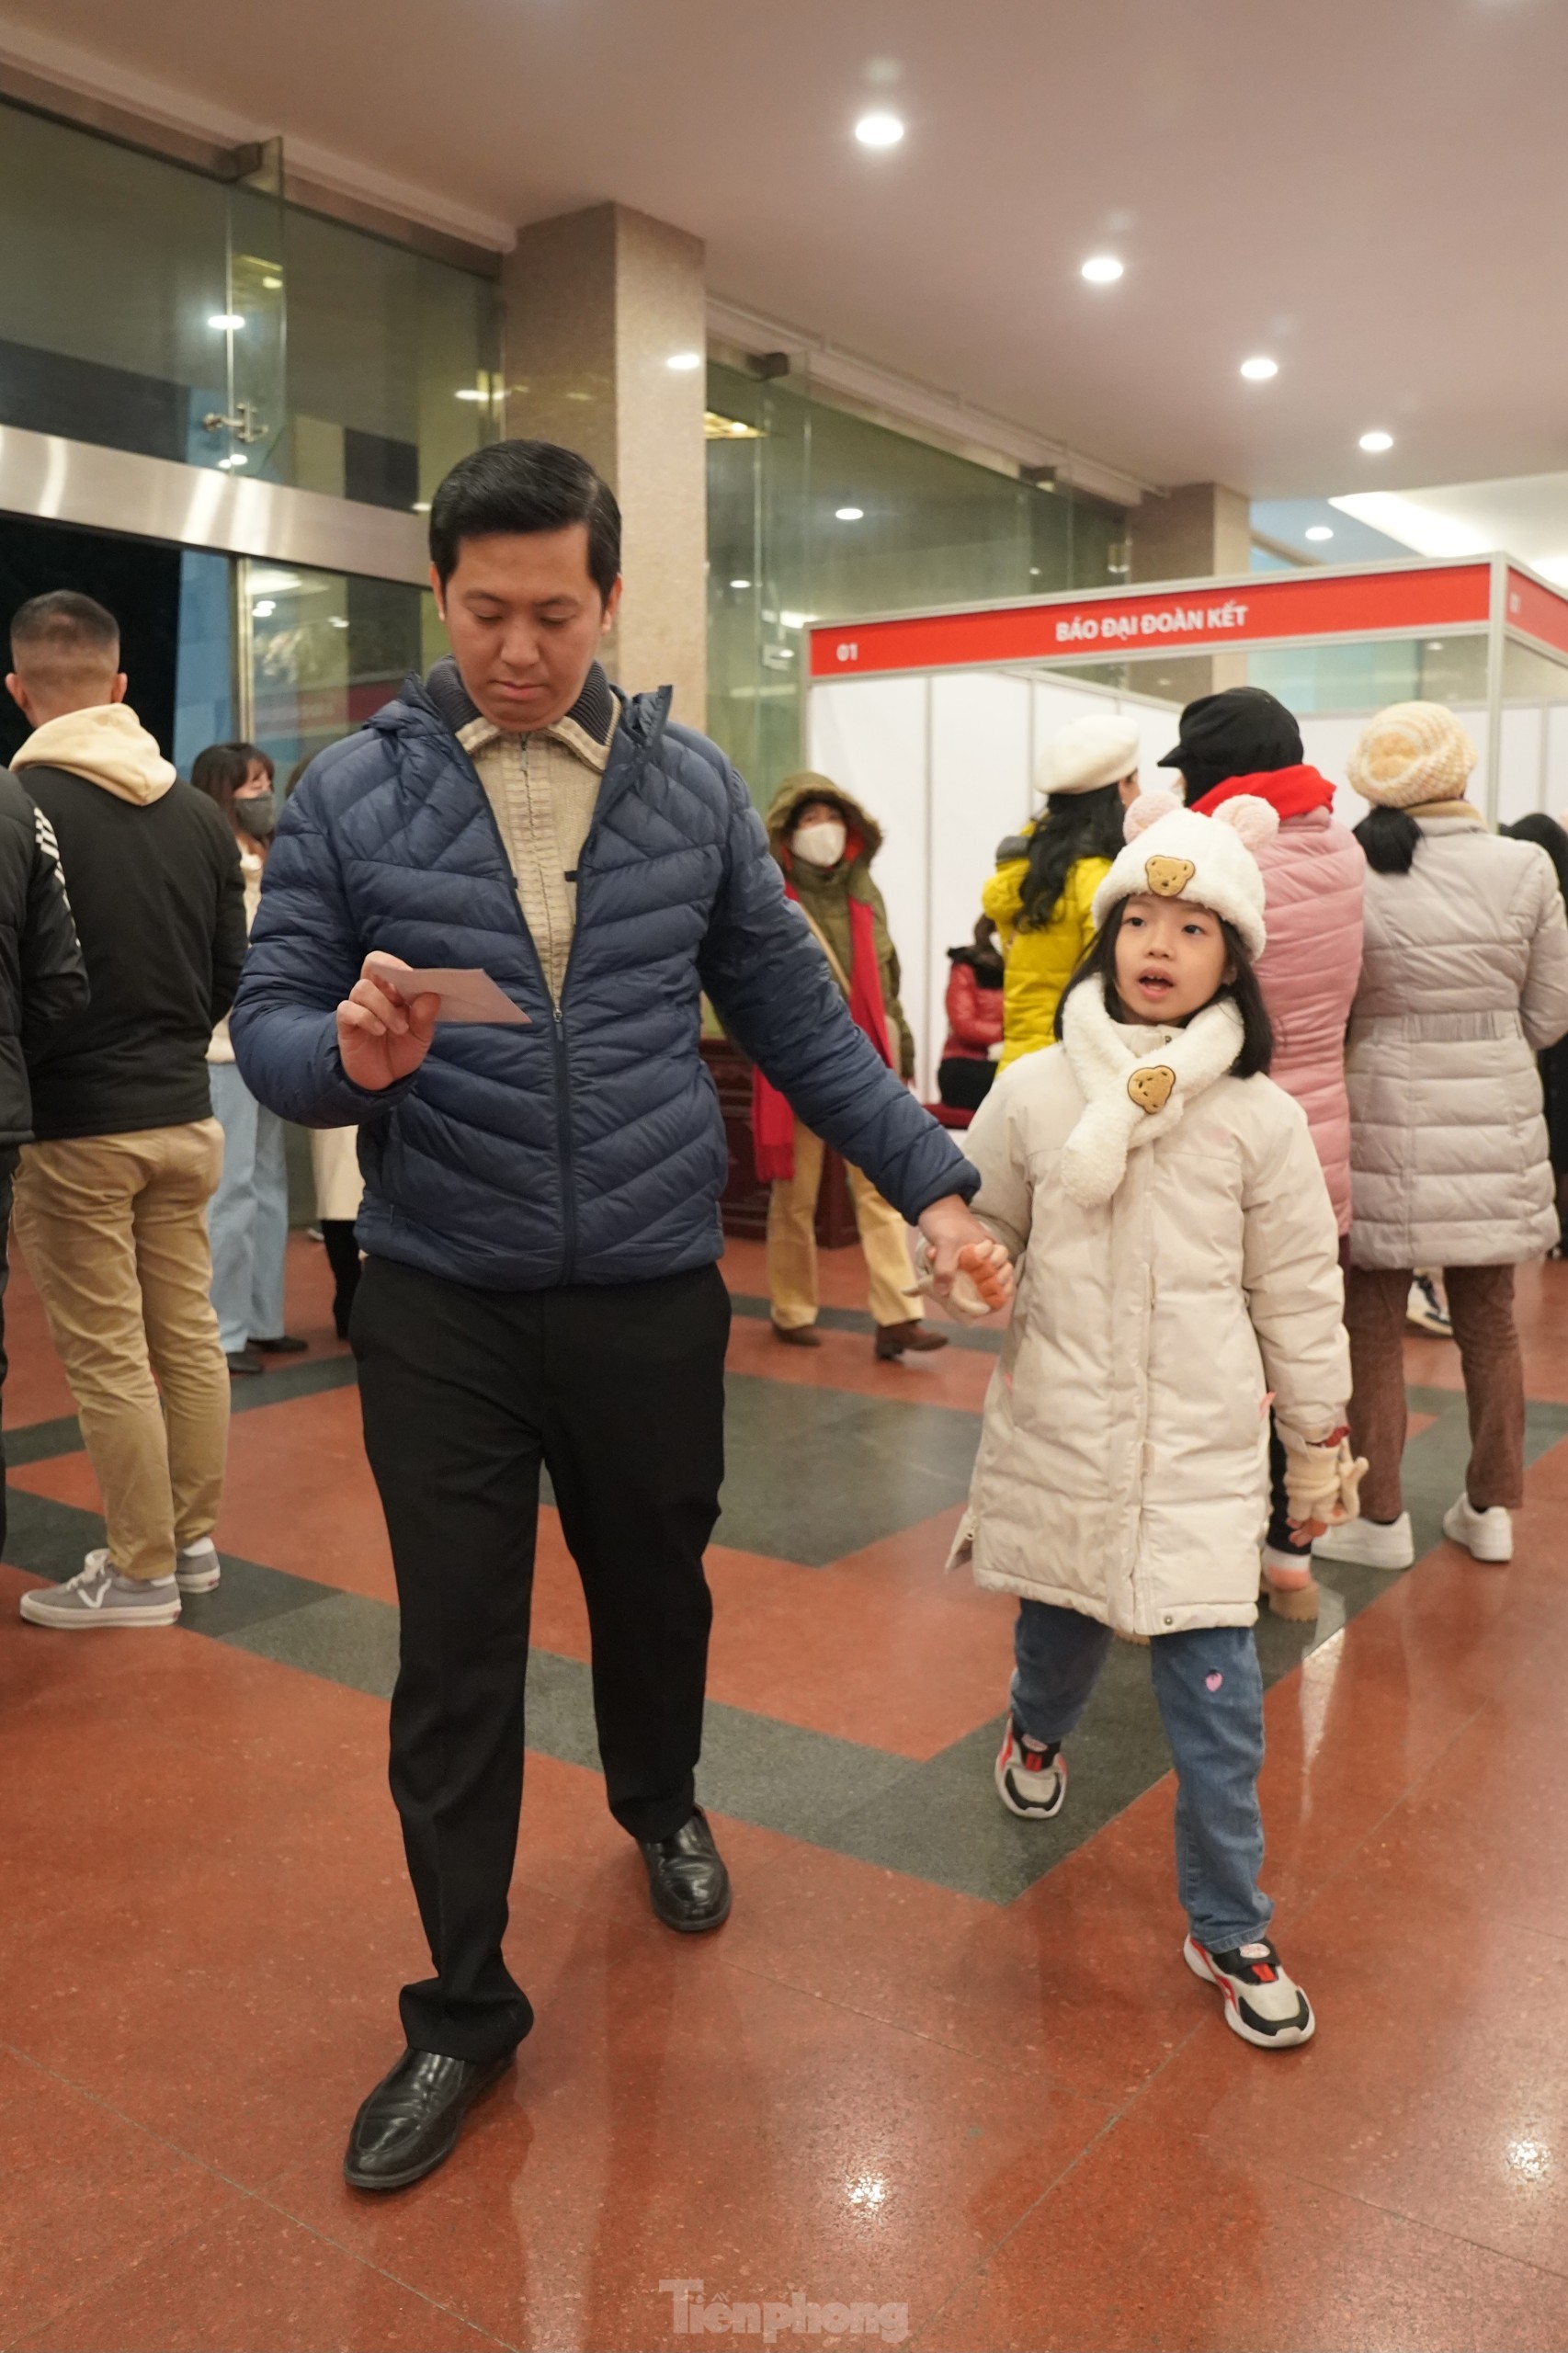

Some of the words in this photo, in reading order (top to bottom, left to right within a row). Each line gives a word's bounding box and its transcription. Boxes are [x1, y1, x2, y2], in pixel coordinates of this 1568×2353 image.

[1055, 616, 1098, 642] BÁO
[1101, 617, 1138, 641] ĐẠI
[1141, 607, 1204, 634] ĐOÀN
[1207, 599, 1249, 628] KẾT
[836, 642, 858, 662] 01
